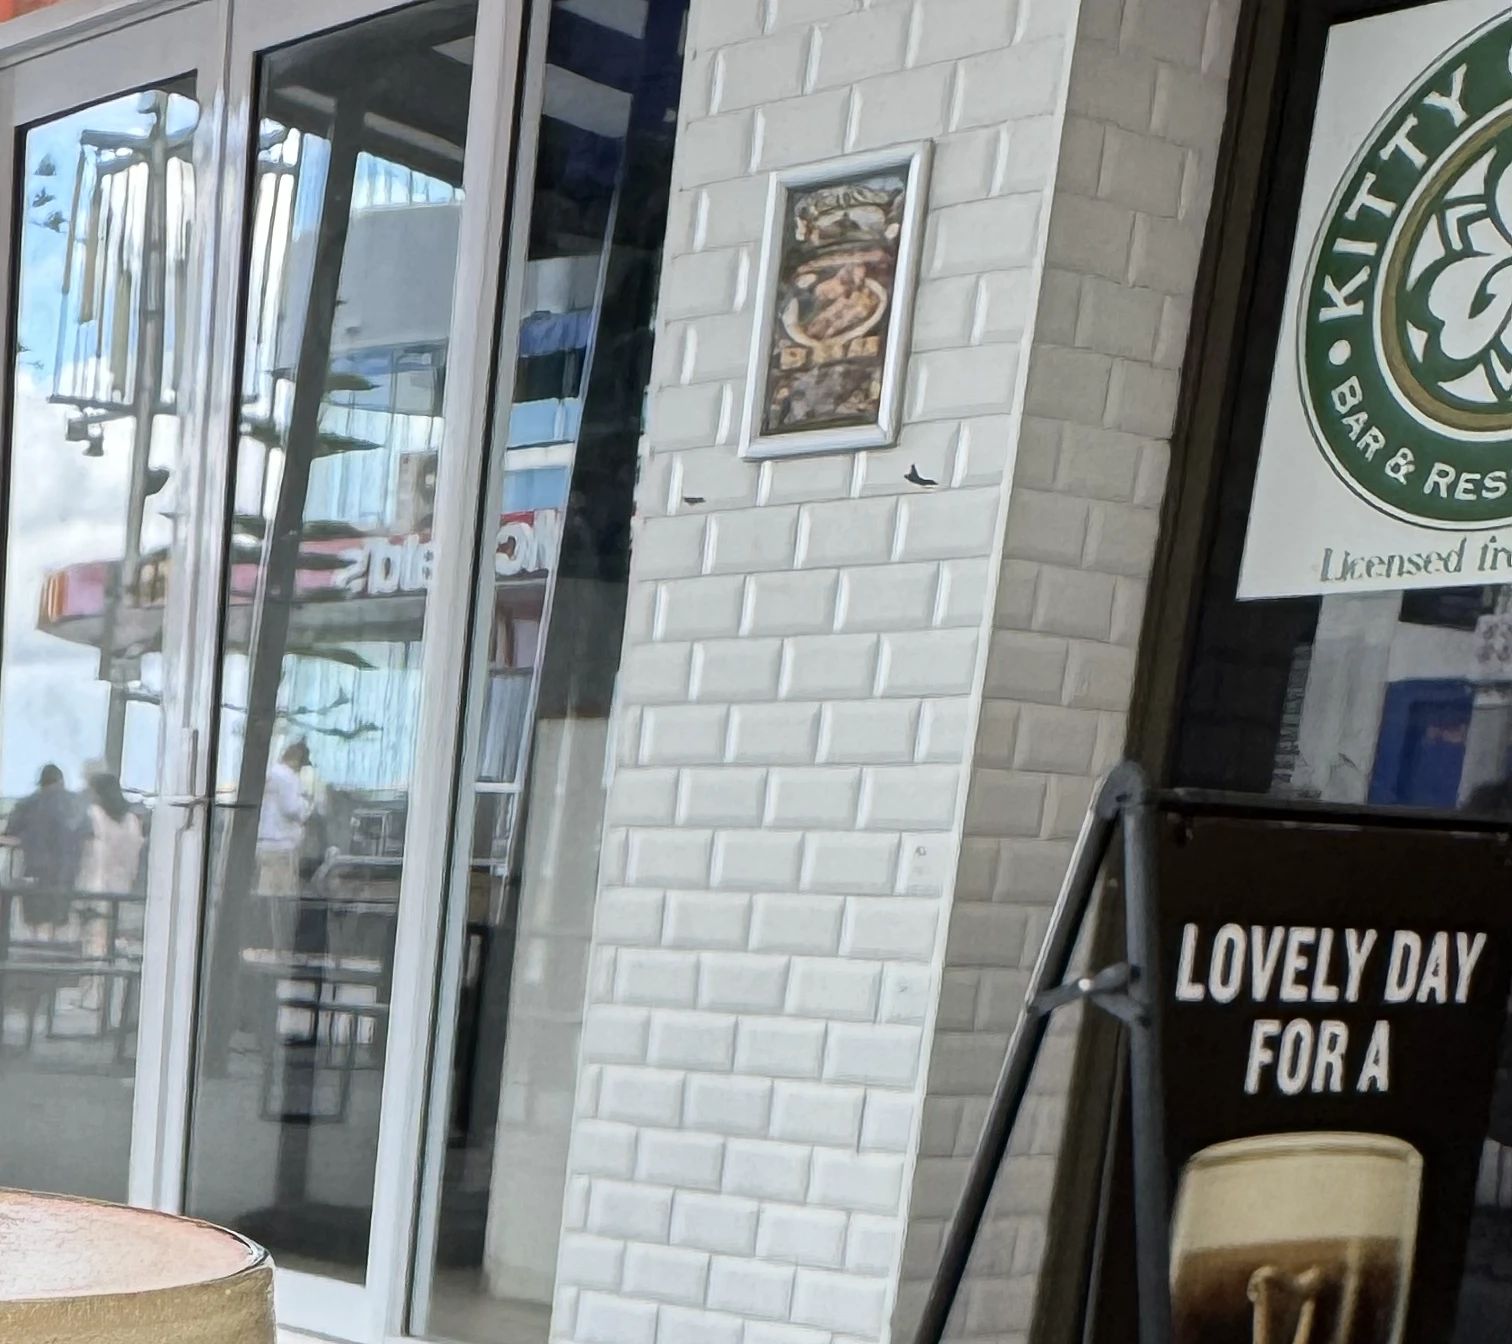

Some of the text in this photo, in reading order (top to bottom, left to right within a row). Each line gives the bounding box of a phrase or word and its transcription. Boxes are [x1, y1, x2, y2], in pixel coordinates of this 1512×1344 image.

[1319, 62, 1469, 324] KITTY
[1331, 375, 1512, 501] BAR & RES
[1320, 536, 1468, 582] Licensed
[1175, 922, 1487, 1004] LOVELY DAY
[1243, 1018, 1389, 1094] FOR A
